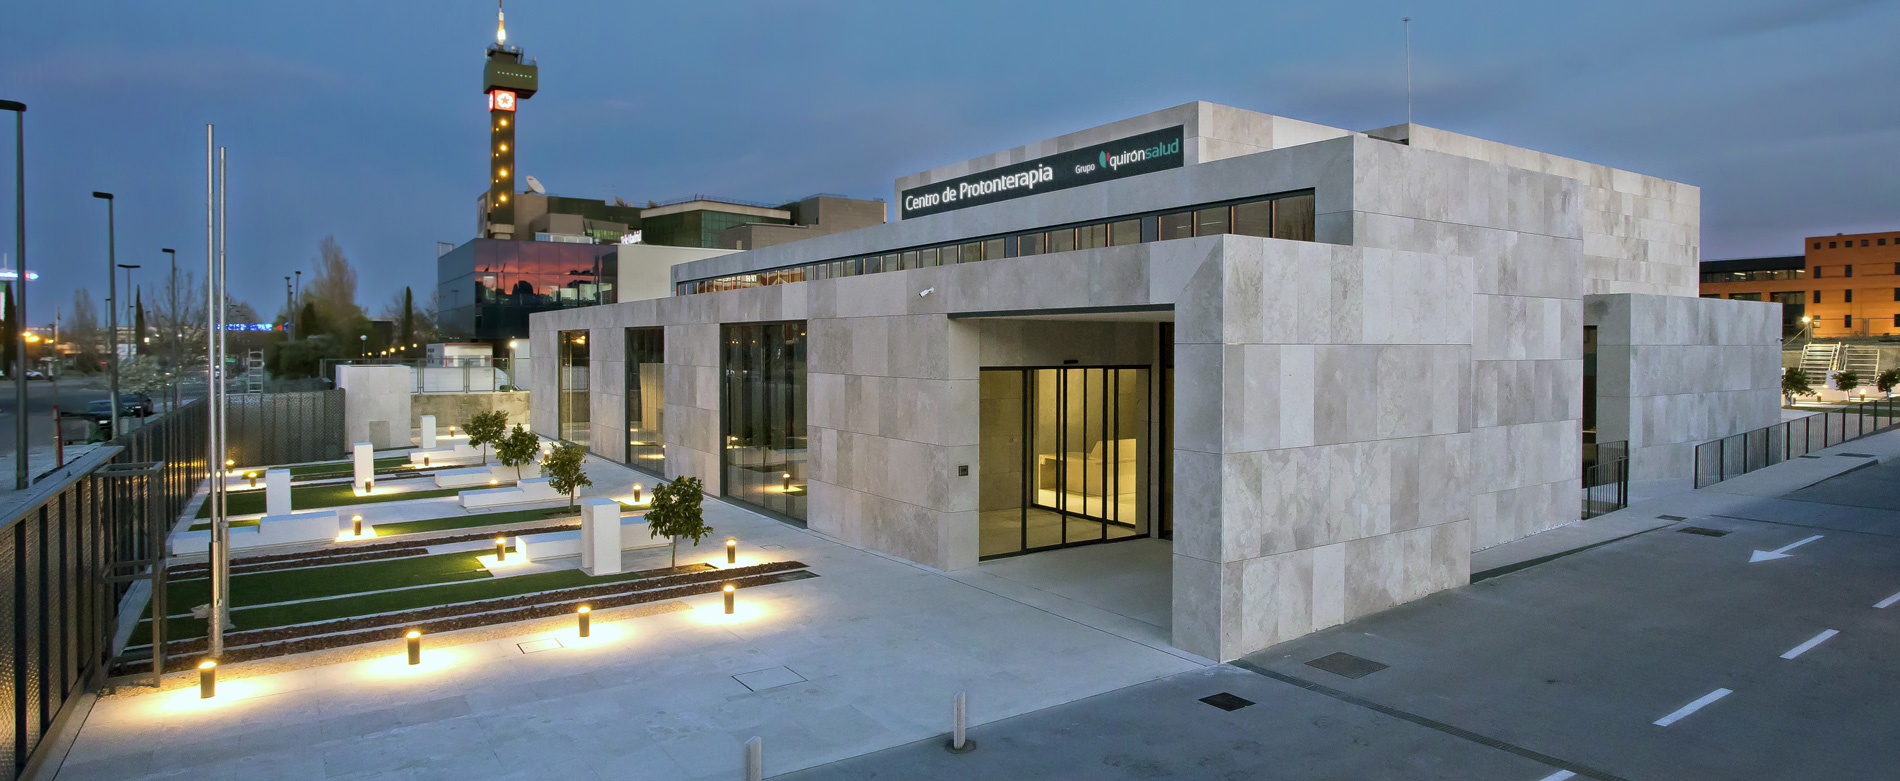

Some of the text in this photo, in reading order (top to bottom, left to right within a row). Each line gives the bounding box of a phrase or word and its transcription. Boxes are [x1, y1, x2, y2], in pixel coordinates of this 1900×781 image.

[1075, 138, 1179, 174] Grupo quirónsalud
[905, 163, 1053, 211] Centro de Protonterapia
